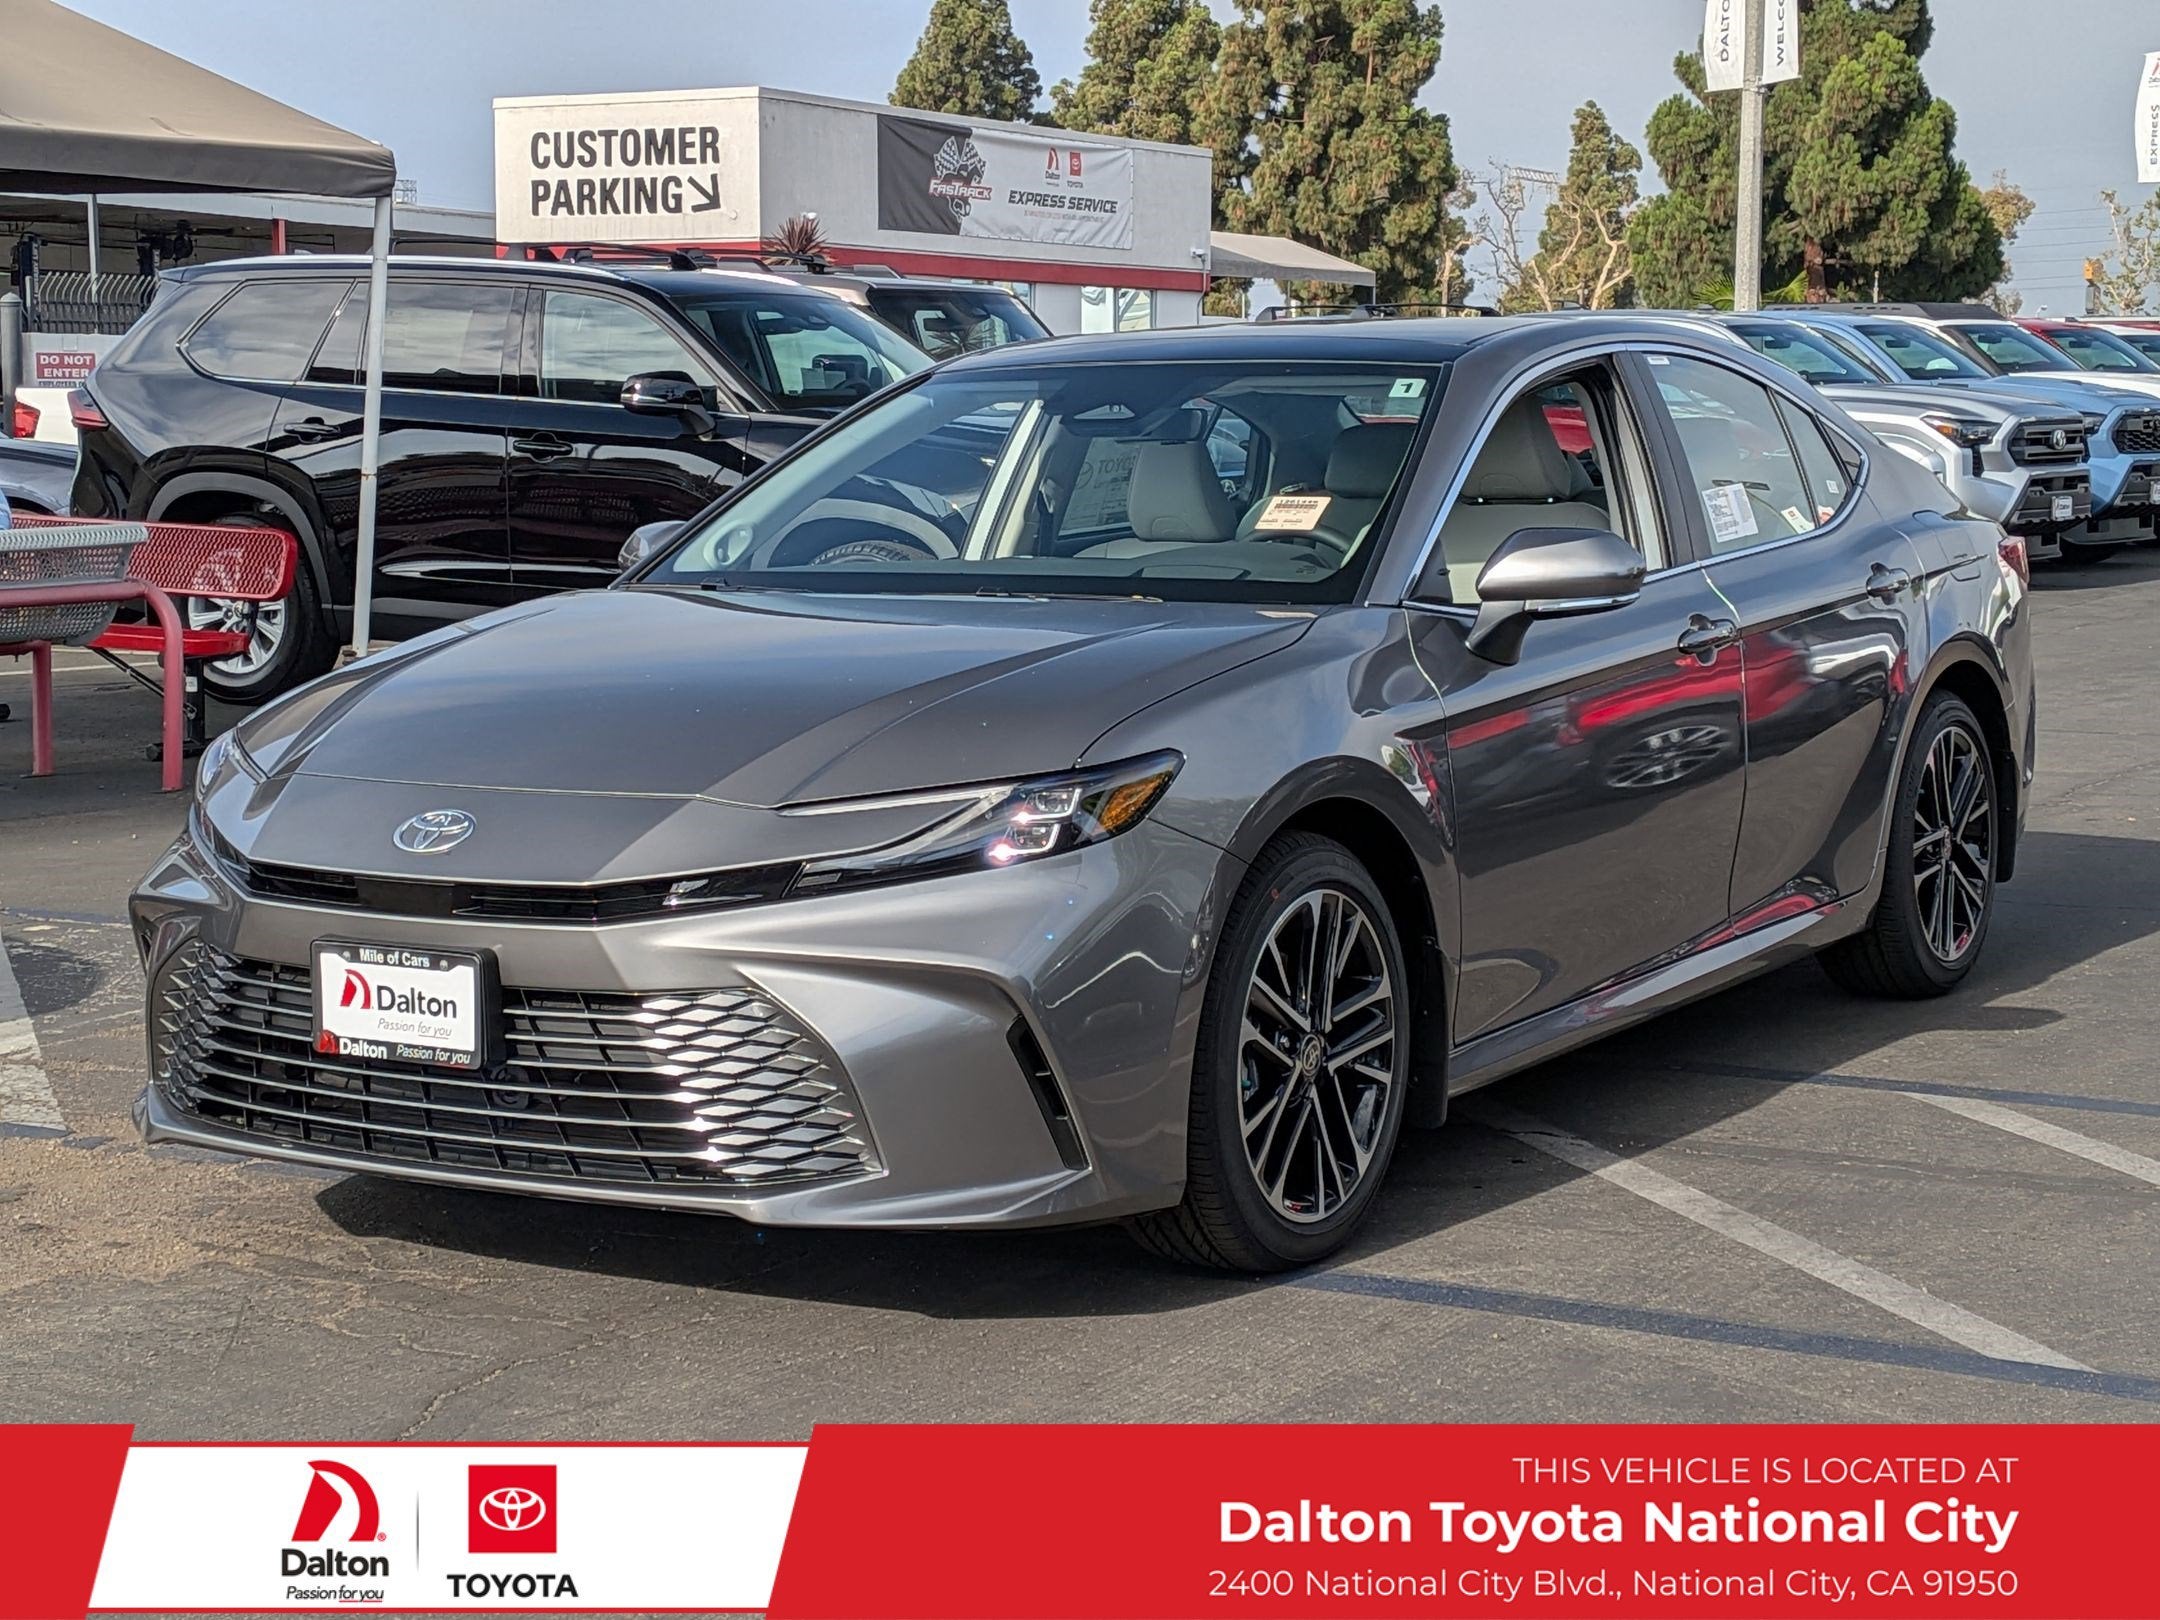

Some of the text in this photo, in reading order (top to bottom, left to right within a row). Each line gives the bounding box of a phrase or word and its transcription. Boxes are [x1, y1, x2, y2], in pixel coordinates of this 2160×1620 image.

[531, 126, 720, 170] CUSTOMER
[531, 175, 683, 216] PARKING
[1008, 190, 1118, 213] EXPRESS SERVICE
[40, 355, 93, 365] DO NOT
[43, 368, 90, 378] ENTER
[1400, 382, 1414, 394] 1
[359, 948, 431, 968] Mile of Cars
[376, 985, 457, 1019] Dalton
[377, 1017, 452, 1038] Passion for you
[339, 1037, 471, 1065] Dalton Passion for you
